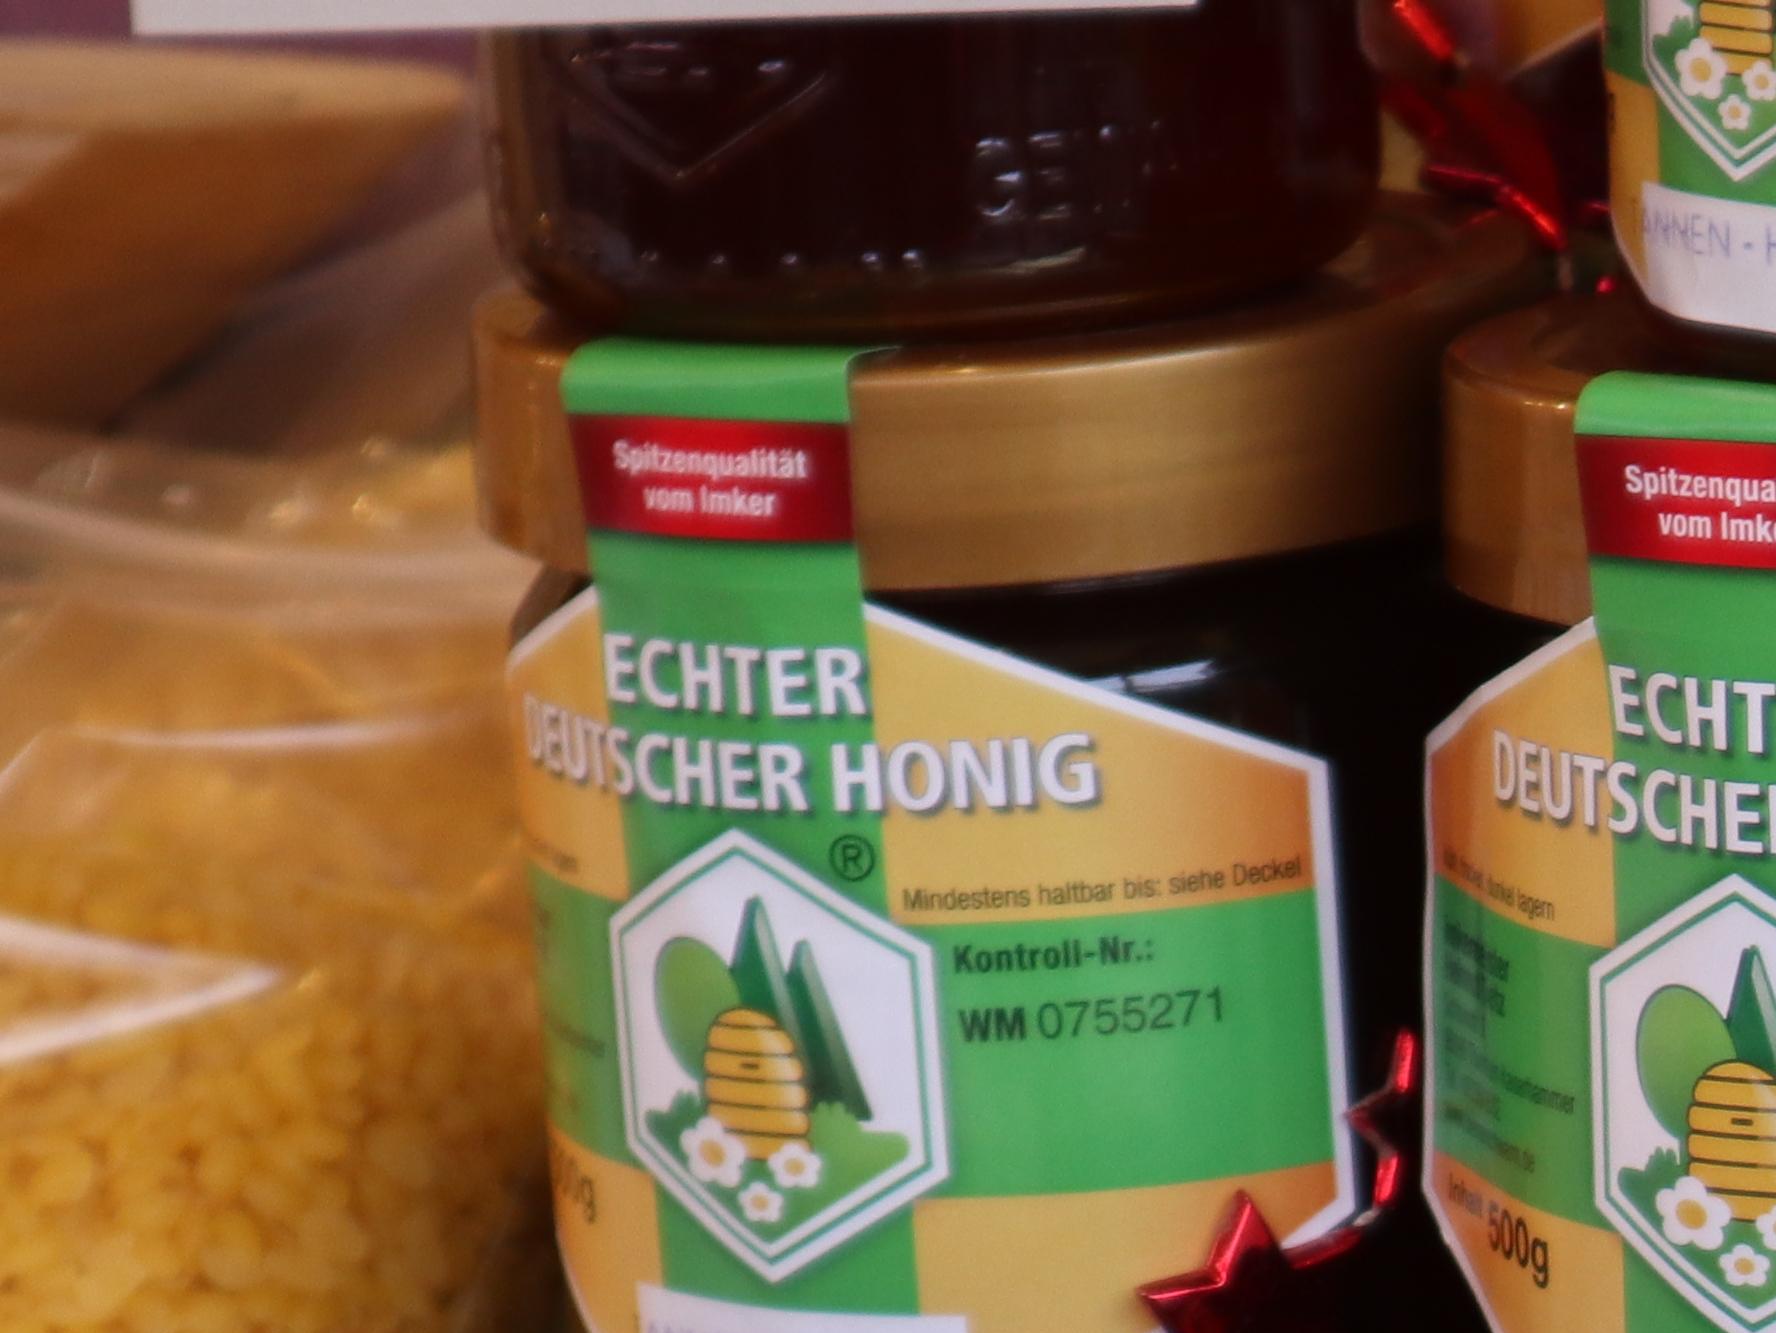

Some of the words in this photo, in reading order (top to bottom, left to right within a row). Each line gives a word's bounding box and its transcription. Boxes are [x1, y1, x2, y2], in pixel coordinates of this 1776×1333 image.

[613, 440, 807, 483] Spitzenqualität
[644, 489, 695, 513] vom
[700, 487, 777, 517] Imker
[1658, 515, 1712, 542] vom
[605, 633, 866, 716] ECHTER
[524, 694, 807, 812] DEUTSCHER
[833, 731, 1099, 812] HONIG
[902, 886, 1031, 914] Mindestens
[1037, 876, 1115, 906] haltbar
[1122, 872, 1163, 899] bis:
[1167, 866, 1226, 897] siehe
[1231, 853, 1302, 888] Deckel
[953, 936, 1155, 976] Kontroll-Nr.:
[959, 1009, 1027, 1043] WM
[1038, 985, 1225, 1040] 0755271
[1486, 1207, 1551, 1287] 500g
